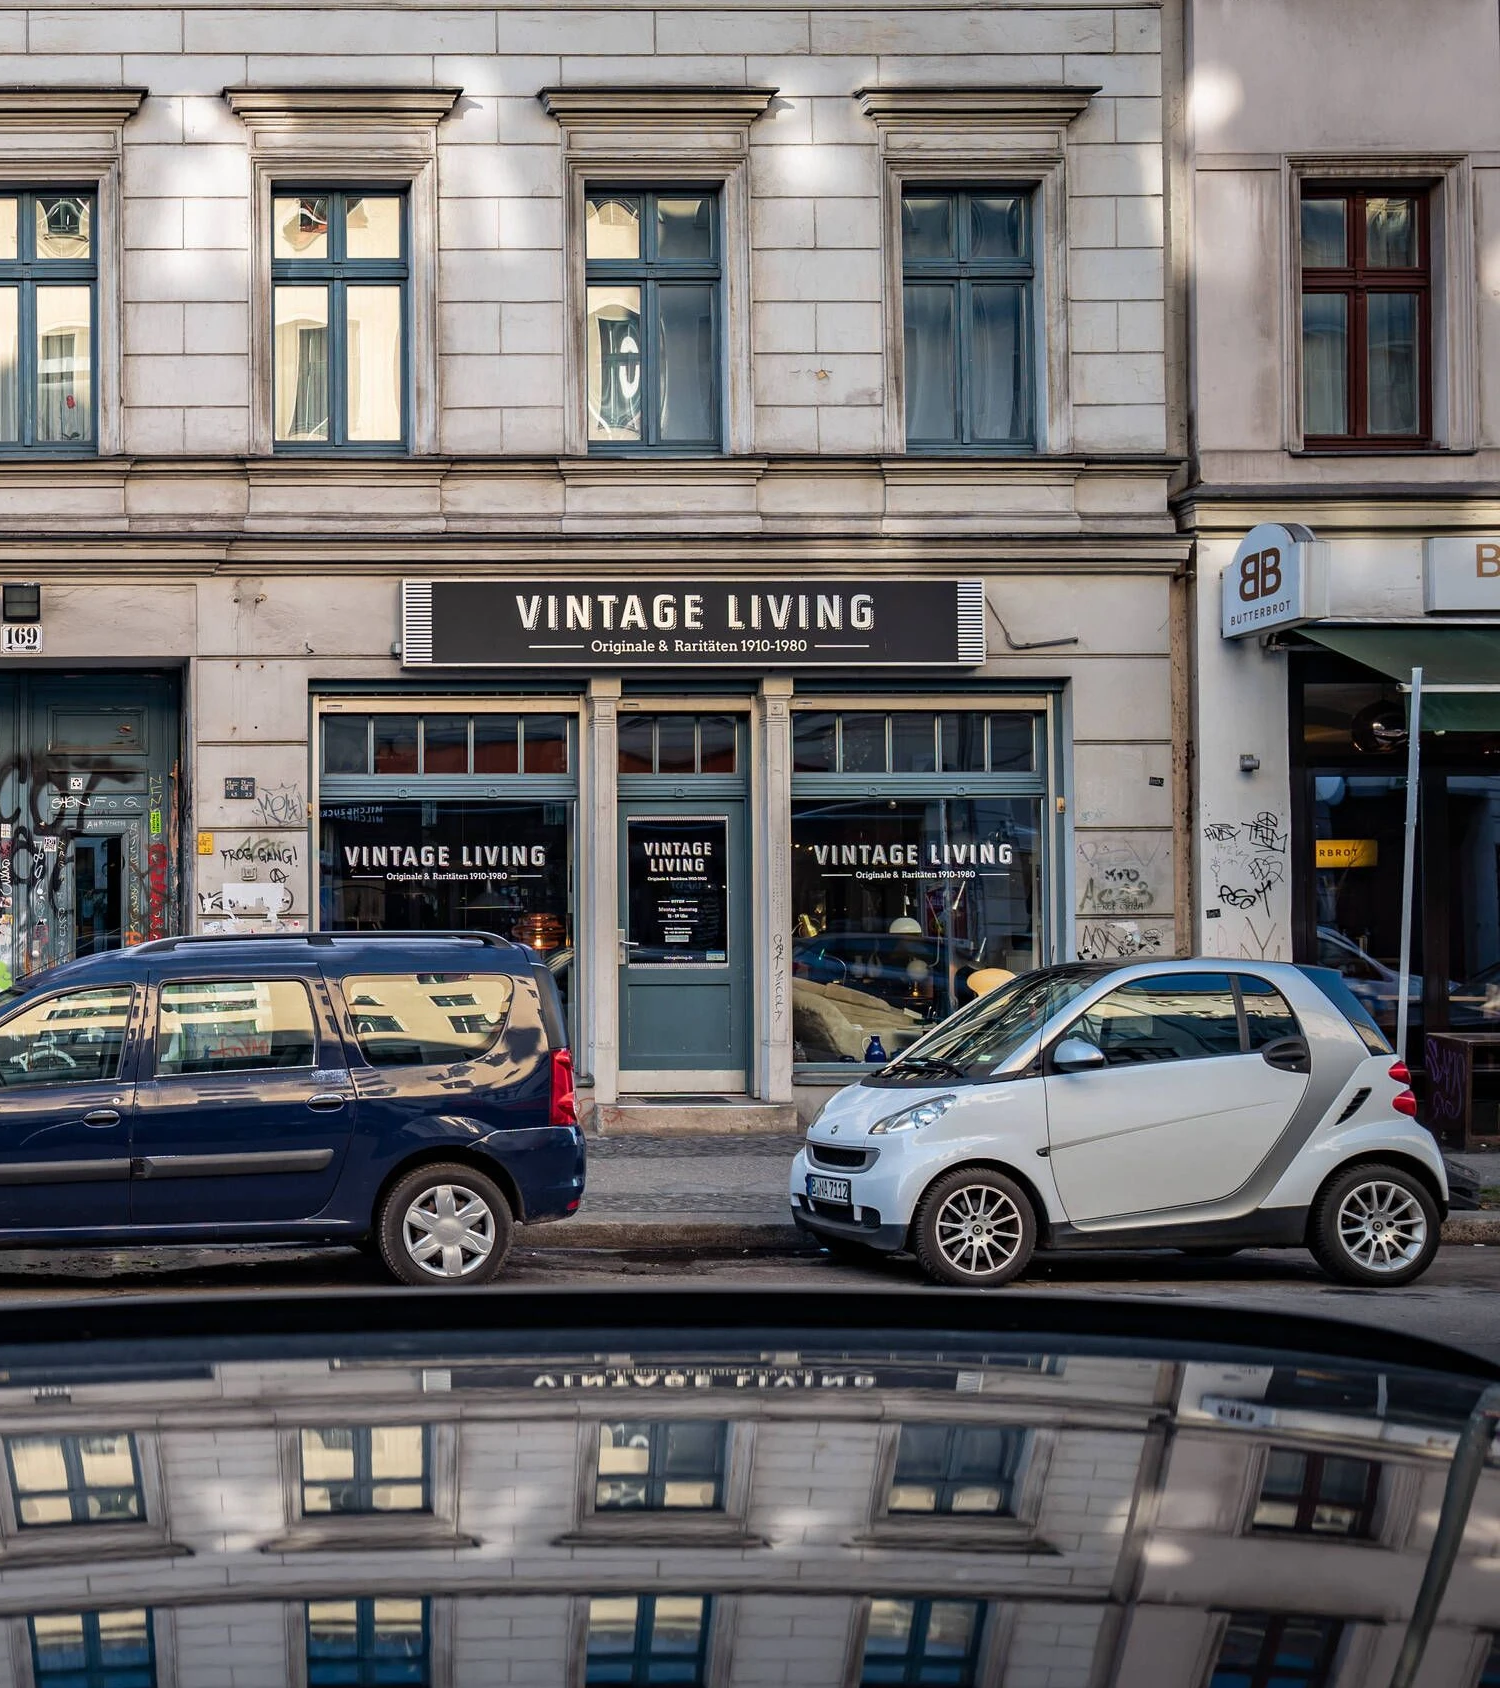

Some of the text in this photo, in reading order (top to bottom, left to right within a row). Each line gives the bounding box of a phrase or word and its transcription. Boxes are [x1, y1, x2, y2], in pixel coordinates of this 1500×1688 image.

[515, 594, 875, 631] VINTAGE LIVING
[1230, 600, 1291, 626] BUTTERBROT
[6, 627, 38, 645] 169
[591, 639, 808, 655] Originale & Raritäten 1910-1980
[344, 845, 546, 867] VINTAGE LIVING
[643, 842, 712, 856] VINTAGE
[814, 843, 1013, 866] VINTAGE LIVING
[650, 858, 705, 872] LIVING
[386, 872, 423, 881] Originale
[433, 872, 469, 880] Raritäten
[469, 872, 508, 880] 1910-1980
[855, 871, 891, 880] Originale
[901, 870, 937, 879] Raritäten
[938, 870, 976, 879] 1910-1980
